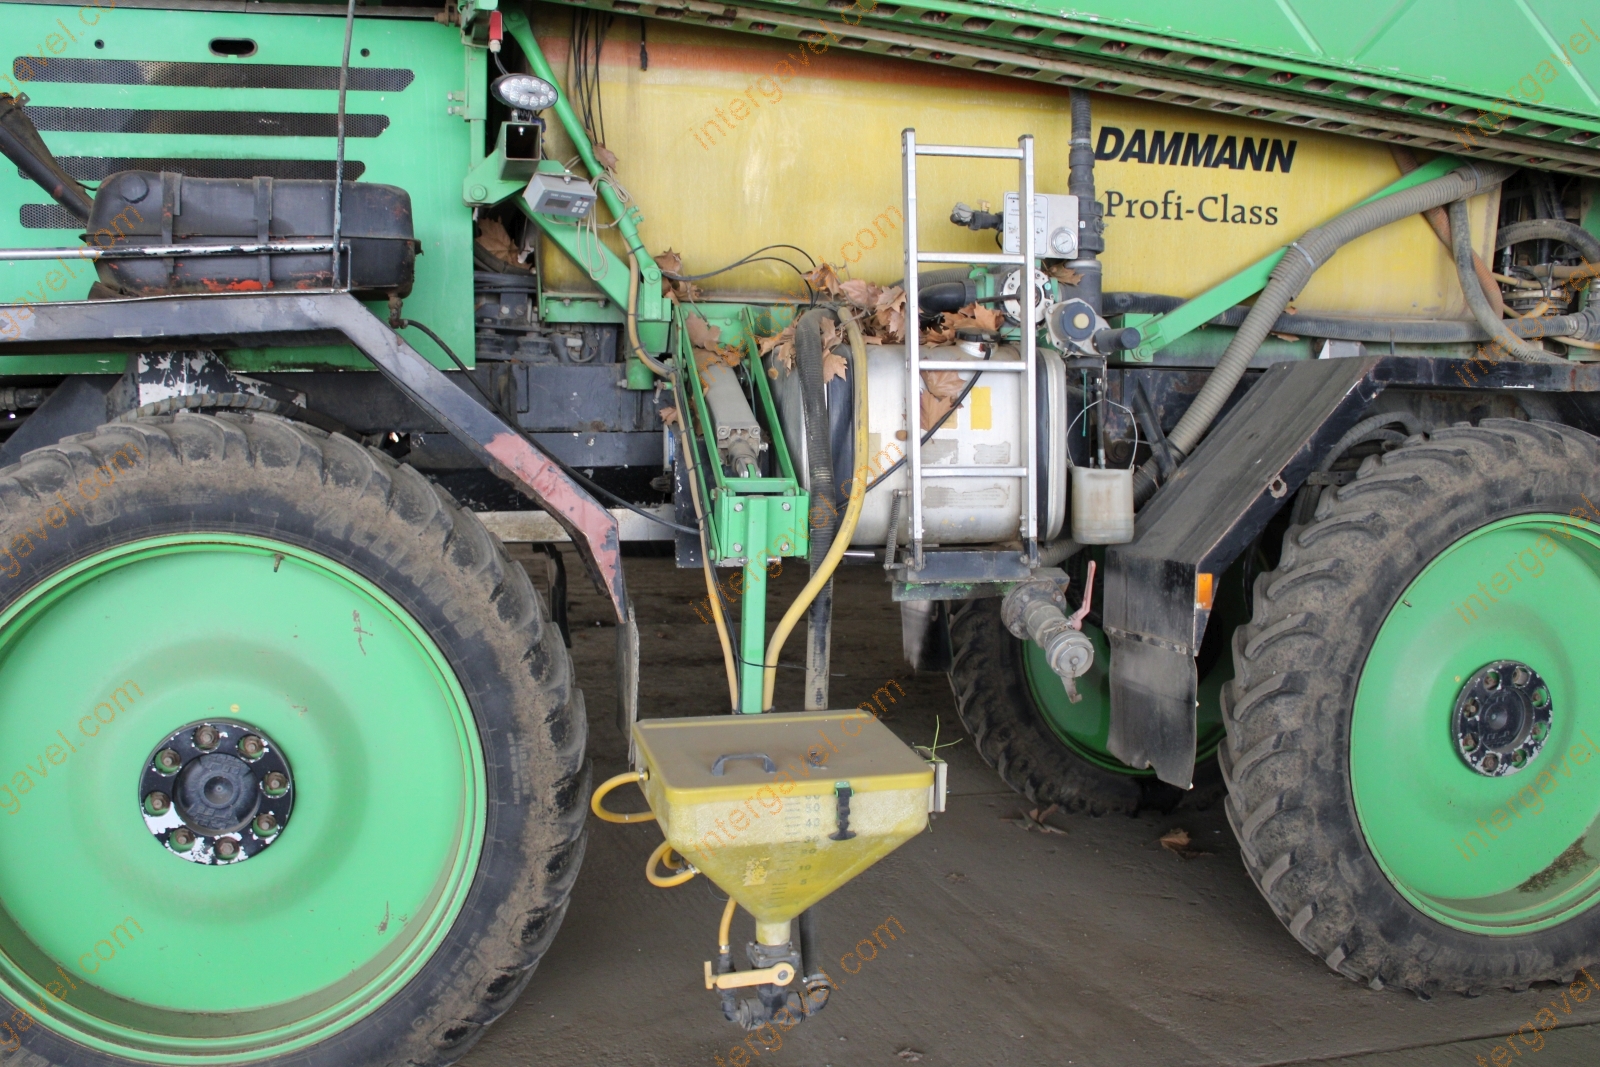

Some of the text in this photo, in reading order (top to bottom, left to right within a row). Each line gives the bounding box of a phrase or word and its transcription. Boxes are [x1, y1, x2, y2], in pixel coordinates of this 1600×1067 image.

[1095, 126, 1297, 173] DAMMANN
[1105, 190, 1278, 225] Profi-Class
[806, 818, 820, 827] 40
